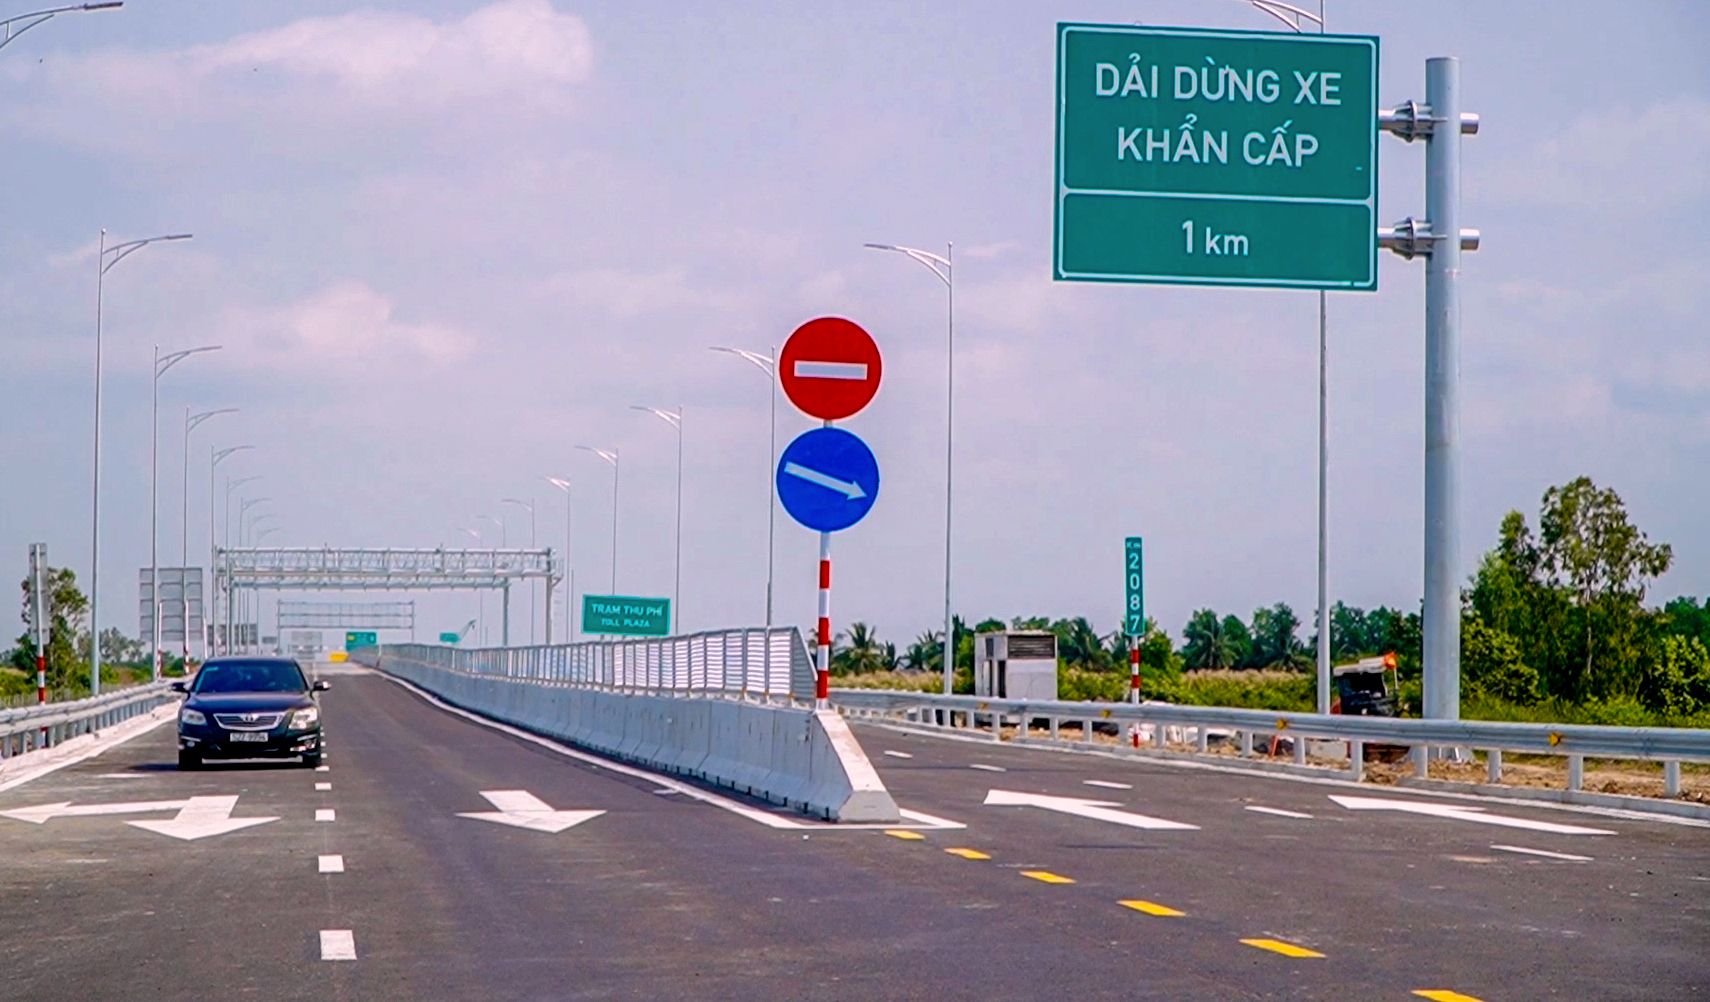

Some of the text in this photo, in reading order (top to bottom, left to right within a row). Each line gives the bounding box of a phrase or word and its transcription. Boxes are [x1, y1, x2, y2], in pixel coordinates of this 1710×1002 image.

[1095, 53, 1342, 105] DẢI DỪNG XE
[1117, 113, 1319, 167] KHẨN CẤP
[1182, 220, 1249, 256] 1 km
[623, 605, 644, 616] THU
[1129, 552, 1141, 632] 2087
[601, 618, 650, 627] TOLL PLAZA
